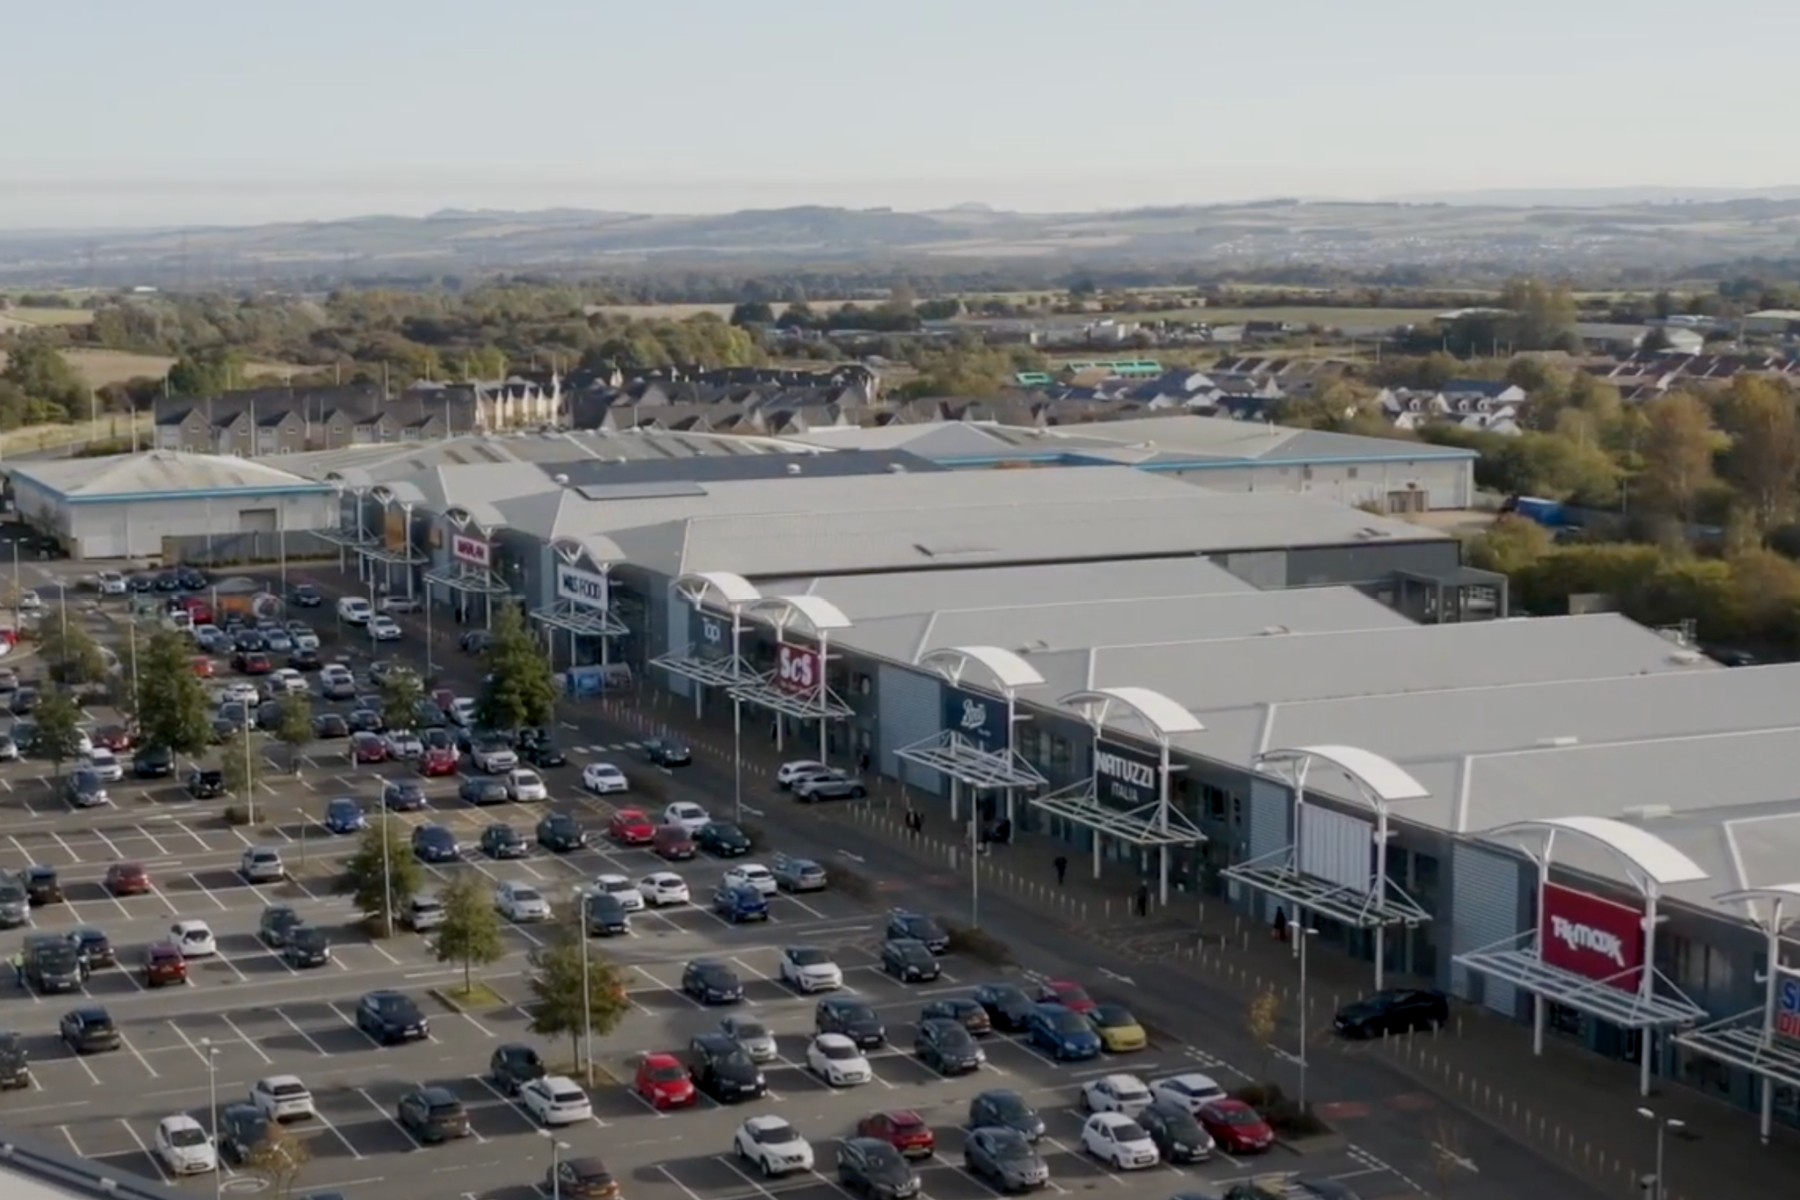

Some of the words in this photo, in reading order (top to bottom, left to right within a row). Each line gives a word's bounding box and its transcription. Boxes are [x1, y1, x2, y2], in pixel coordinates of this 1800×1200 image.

[580, 577, 602, 600] FOOD
[780, 647, 812, 686] ScS
[1094, 750, 1154, 789] NATUZZI
[1111, 780, 1139, 803] ITALIA
